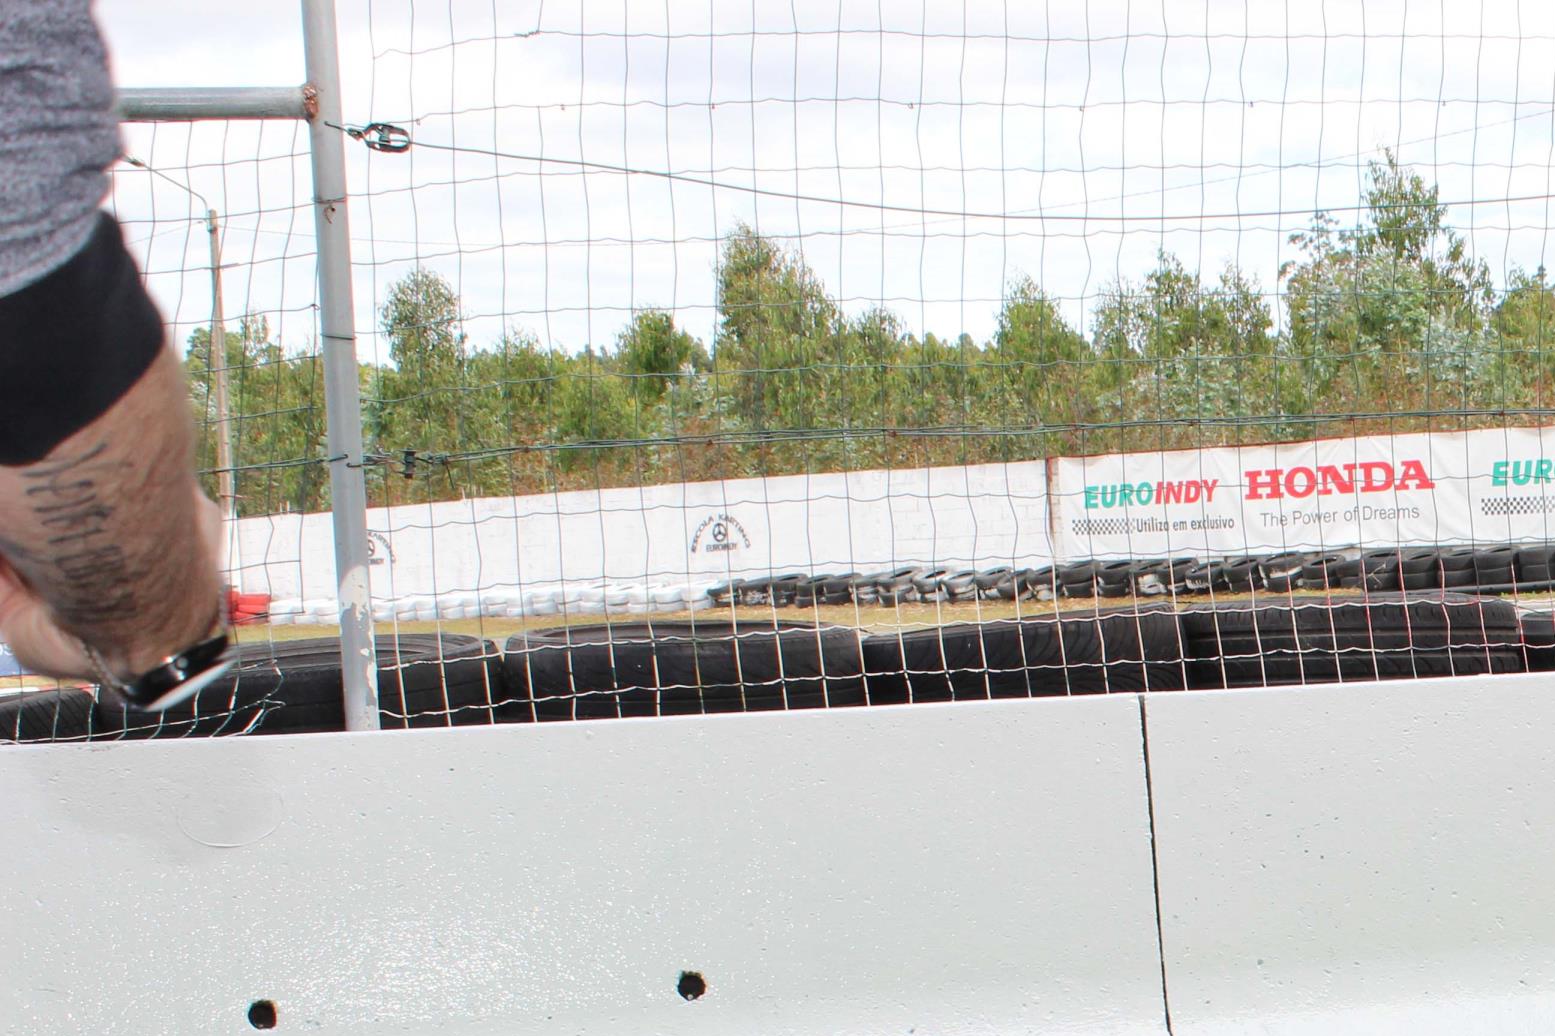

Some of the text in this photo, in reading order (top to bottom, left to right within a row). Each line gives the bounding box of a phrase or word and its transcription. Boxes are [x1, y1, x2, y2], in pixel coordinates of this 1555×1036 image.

[1244, 459, 1436, 501] HONDA
[1084, 479, 1220, 510] EUROINDY
[1173, 518, 1189, 531] em
[1190, 515, 1235, 531] exclusivo
[1259, 504, 1420, 529] The Power of Dreams
